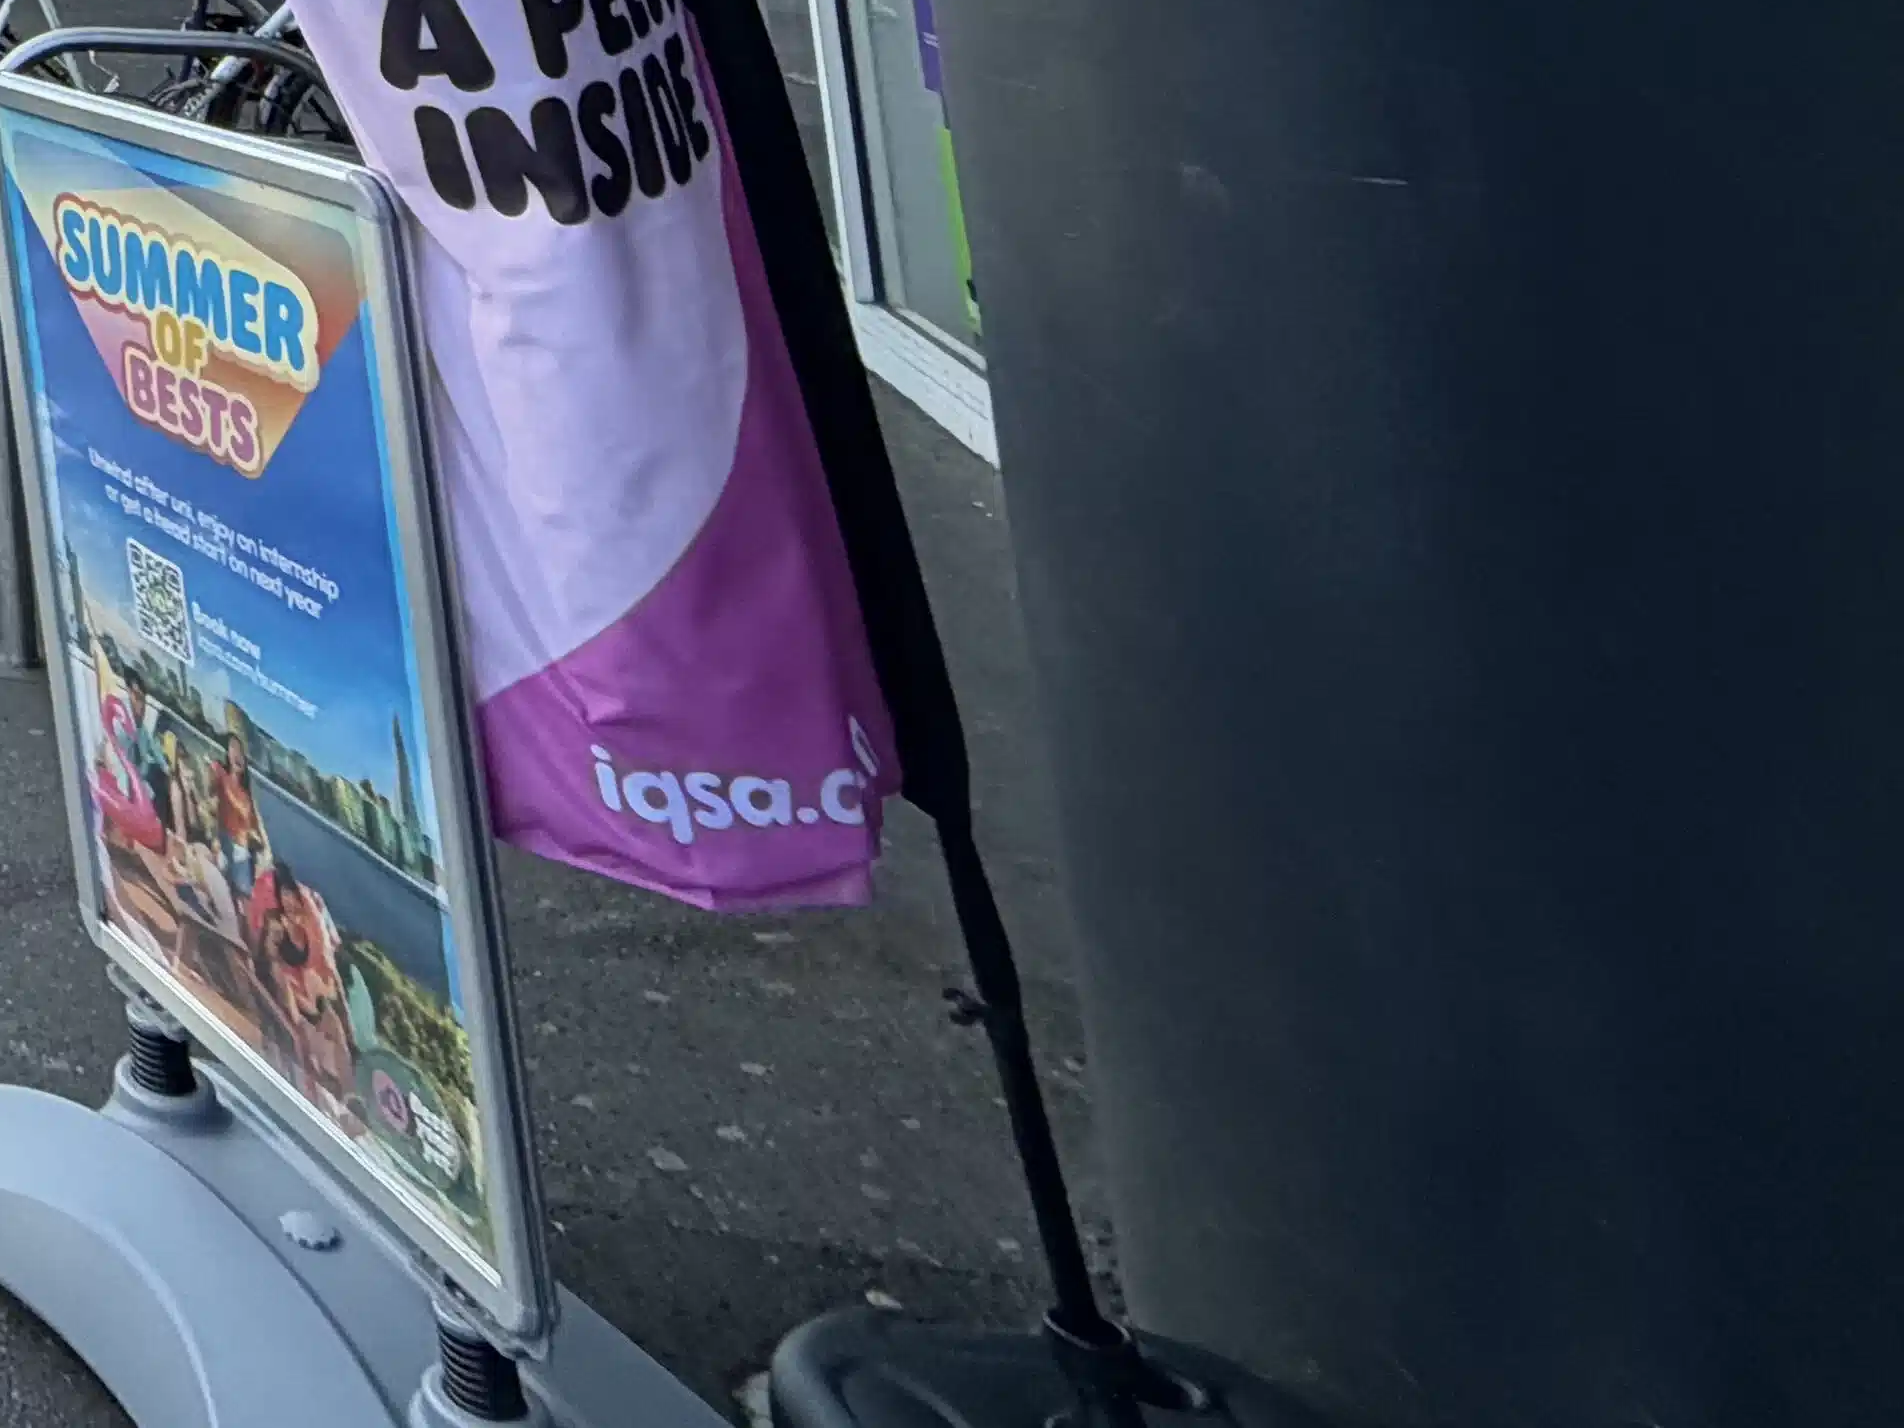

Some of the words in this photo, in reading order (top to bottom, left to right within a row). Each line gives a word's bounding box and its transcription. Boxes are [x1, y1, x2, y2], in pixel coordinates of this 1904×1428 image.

[414, 34, 711, 226] INSIDE
[62, 208, 306, 372] SUMMER
[155, 311, 206, 373] OF
[128, 352, 256, 465] BESTS
